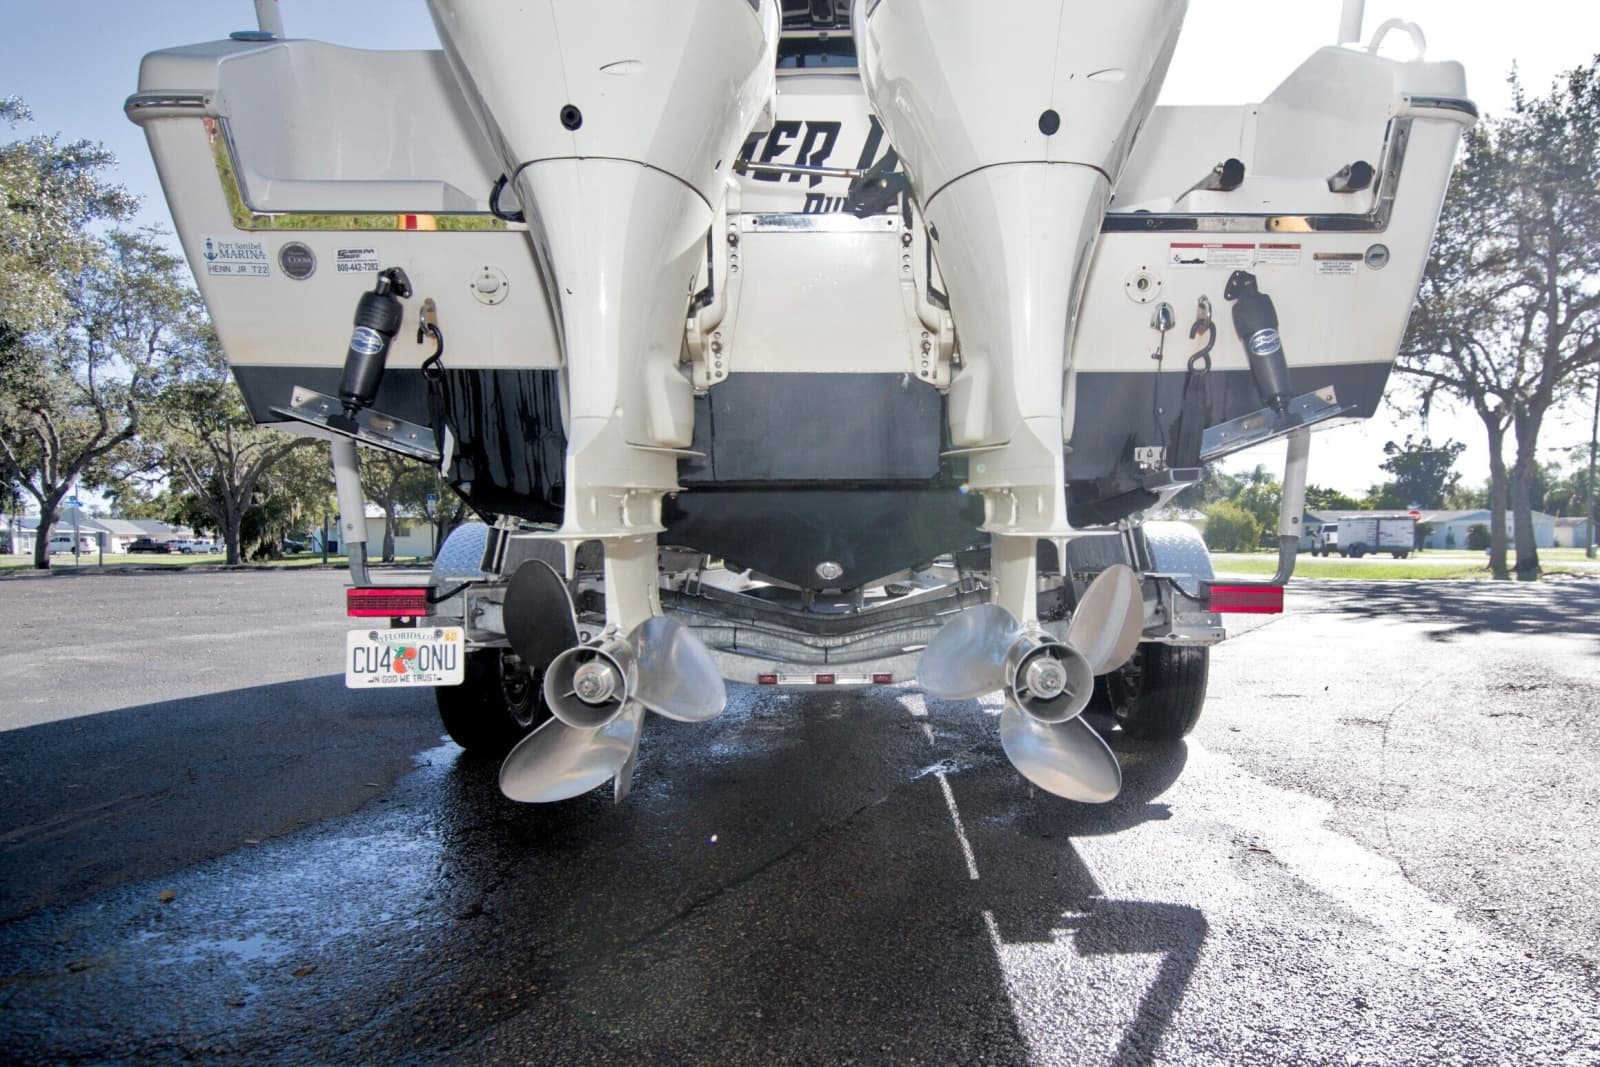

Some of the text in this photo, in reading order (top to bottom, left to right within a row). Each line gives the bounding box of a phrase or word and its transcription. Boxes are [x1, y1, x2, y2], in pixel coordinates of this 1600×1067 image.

[217, 240, 262, 251] Port Sanibel
[218, 249, 267, 260] MARINA
[208, 263, 268, 275] HENN JR T22
[353, 646, 391, 674] CU4
[382, 675, 398, 683] GOD
[400, 674, 410, 682] WE
[413, 673, 437, 682] TRUST
